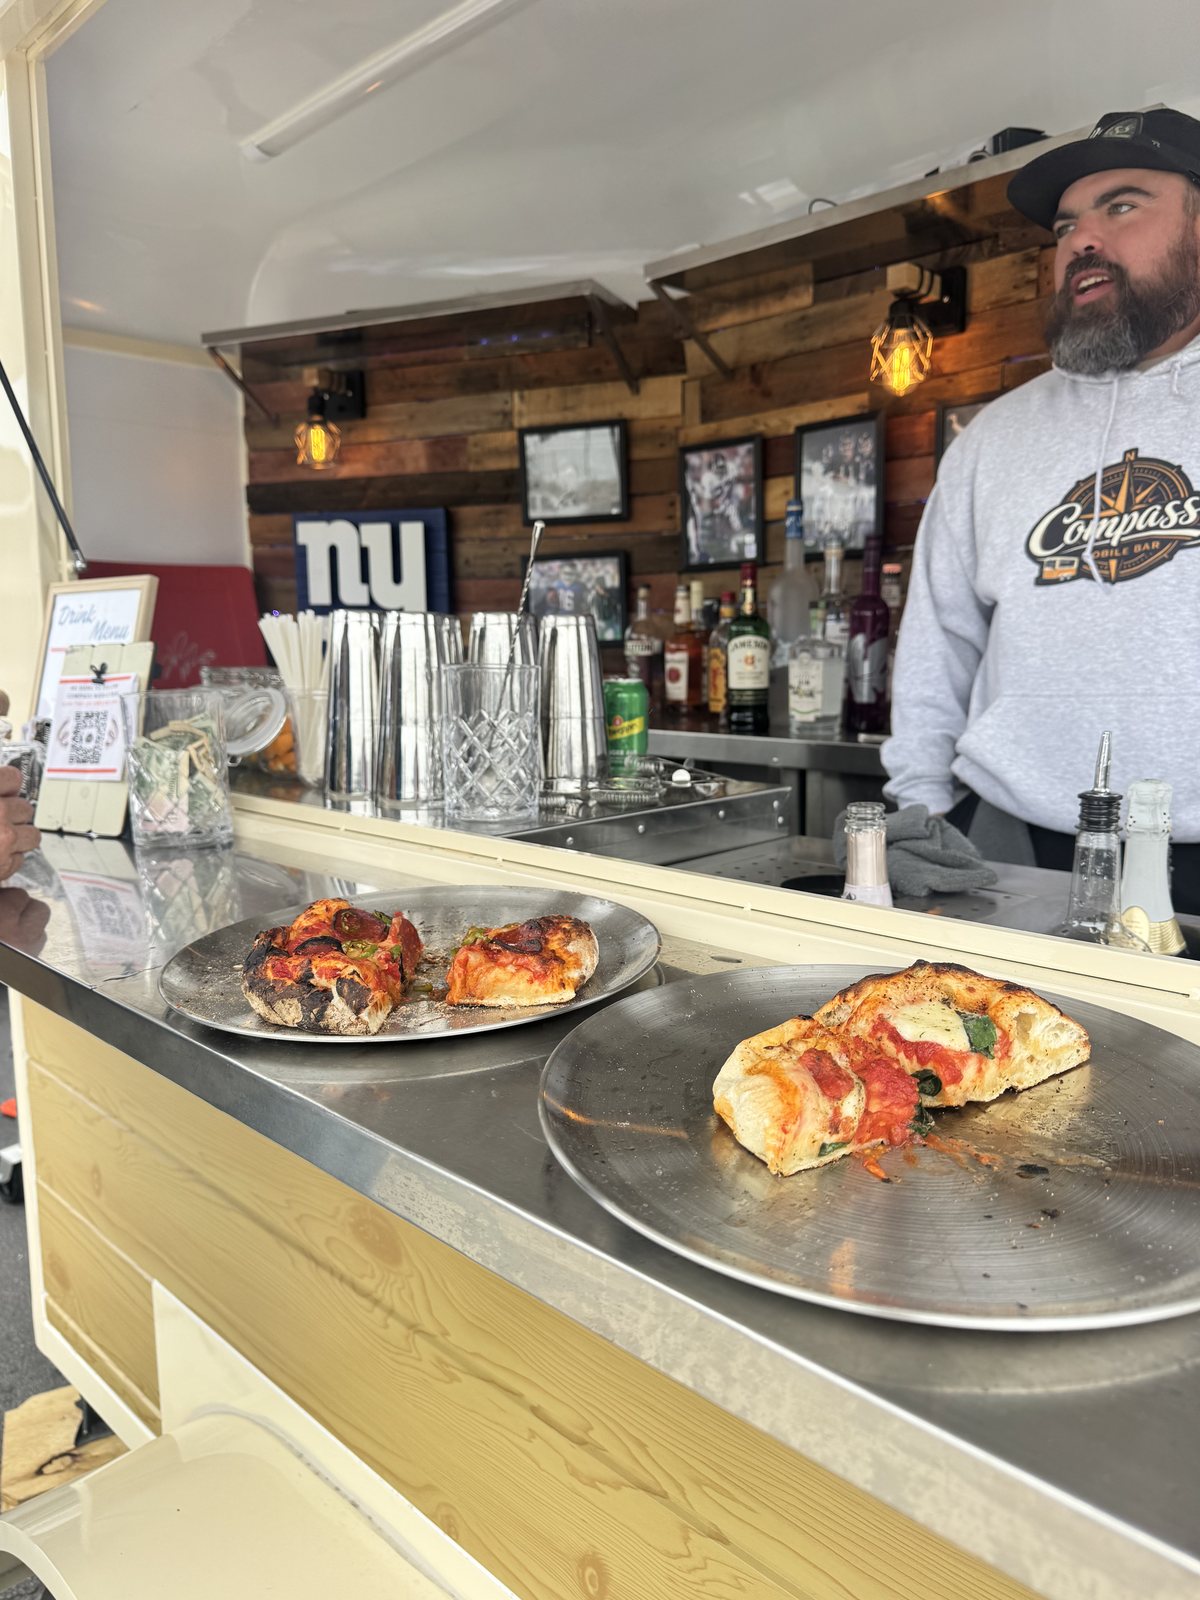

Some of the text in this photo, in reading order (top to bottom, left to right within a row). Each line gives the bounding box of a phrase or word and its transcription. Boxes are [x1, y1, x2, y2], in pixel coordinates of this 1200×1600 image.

[1126, 452, 1135, 461] N
[1029, 496, 1200, 557] Compass
[1092, 541, 1160, 559] OBILE BAR
[58, 604, 96, 625] Drink
[89, 620, 129, 641] Menu
